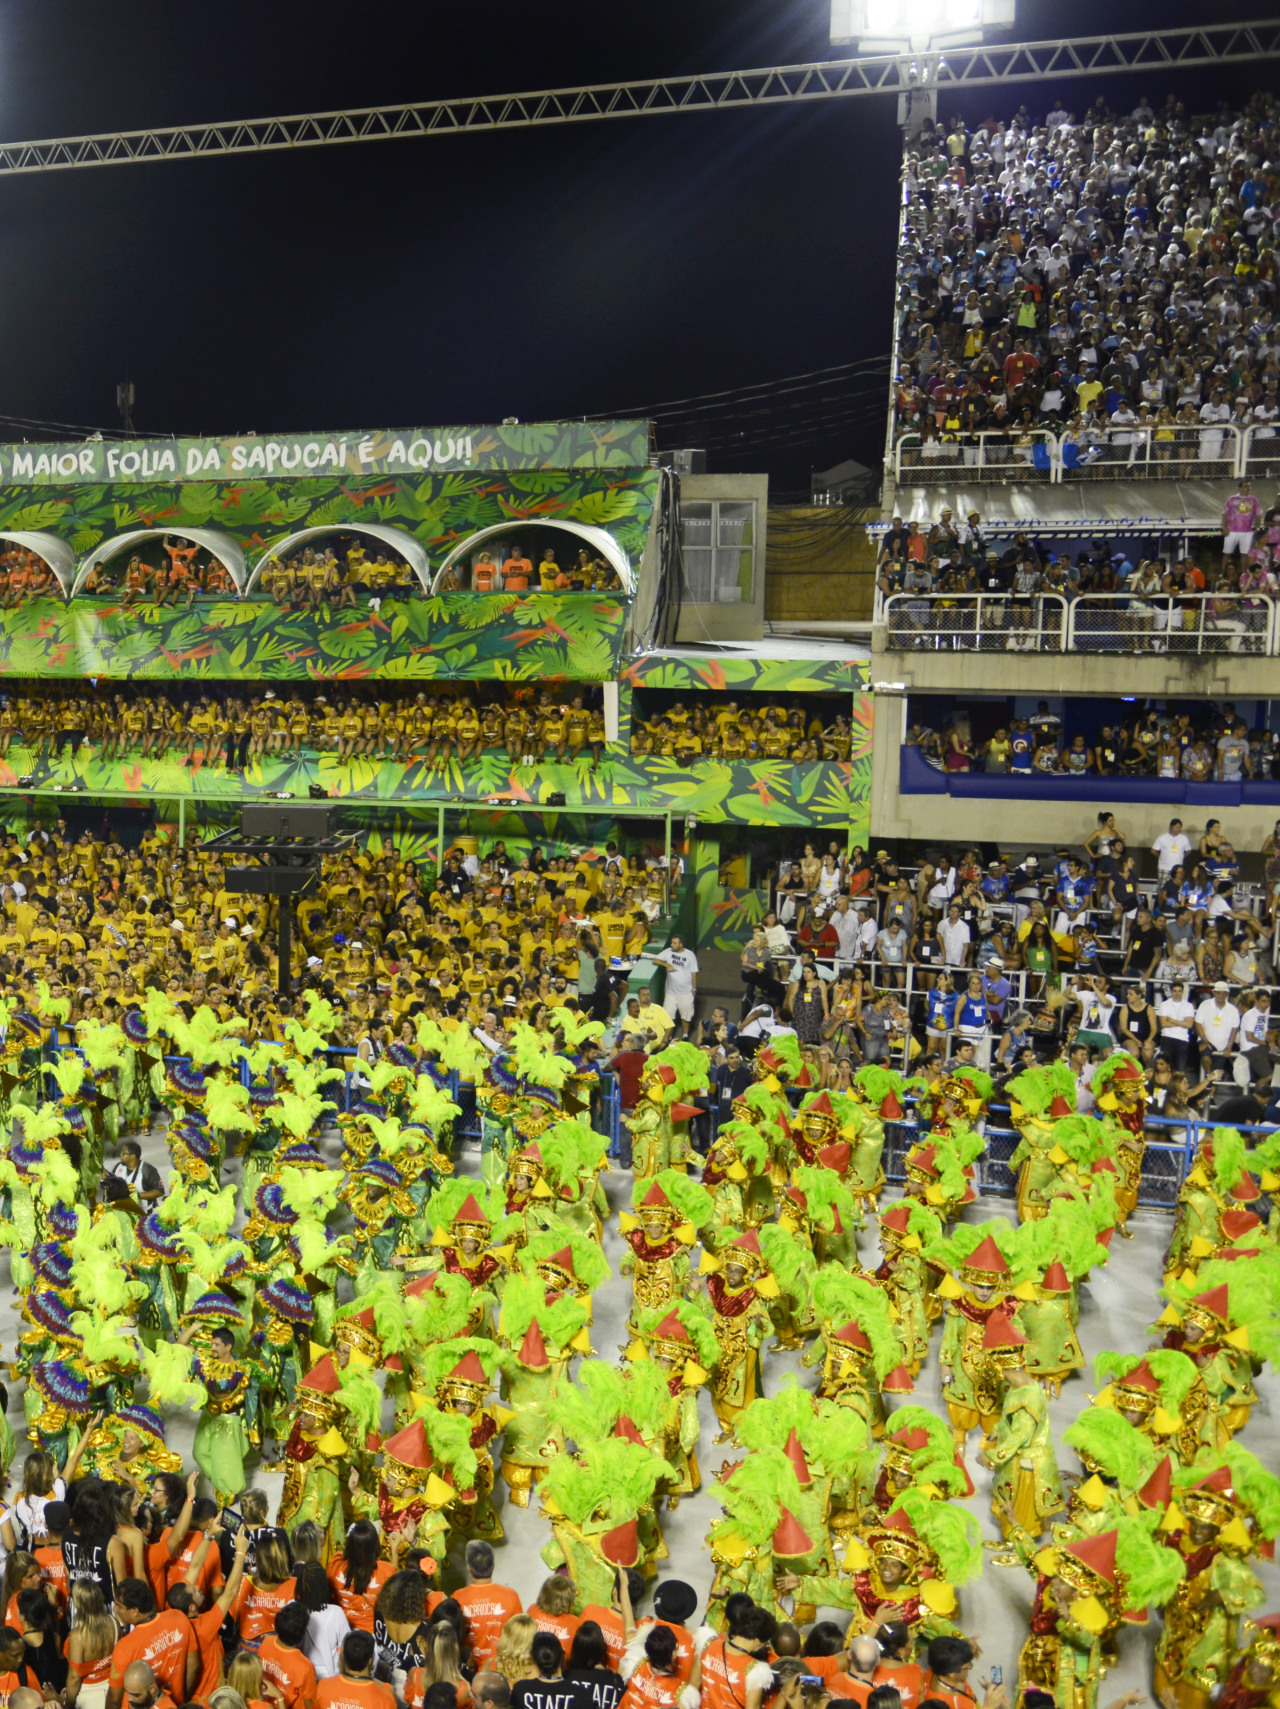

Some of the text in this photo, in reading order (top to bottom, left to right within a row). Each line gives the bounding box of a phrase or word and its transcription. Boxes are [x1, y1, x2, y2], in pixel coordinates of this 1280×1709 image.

[12, 448, 97, 479] MAIOR
[106, 448, 176, 478] FOLIA
[185, 446, 221, 475] DA
[231, 434, 348, 474] SAPUCAÍ
[358, 434, 375, 464] É
[386, 435, 472, 469] AQUI!
[252, 1596, 280, 1608] CARIOCA
[468, 1602, 495, 1616] CARIOCA
[523, 1692, 575, 1709] STAFF
[572, 1680, 623, 1709] AFF
